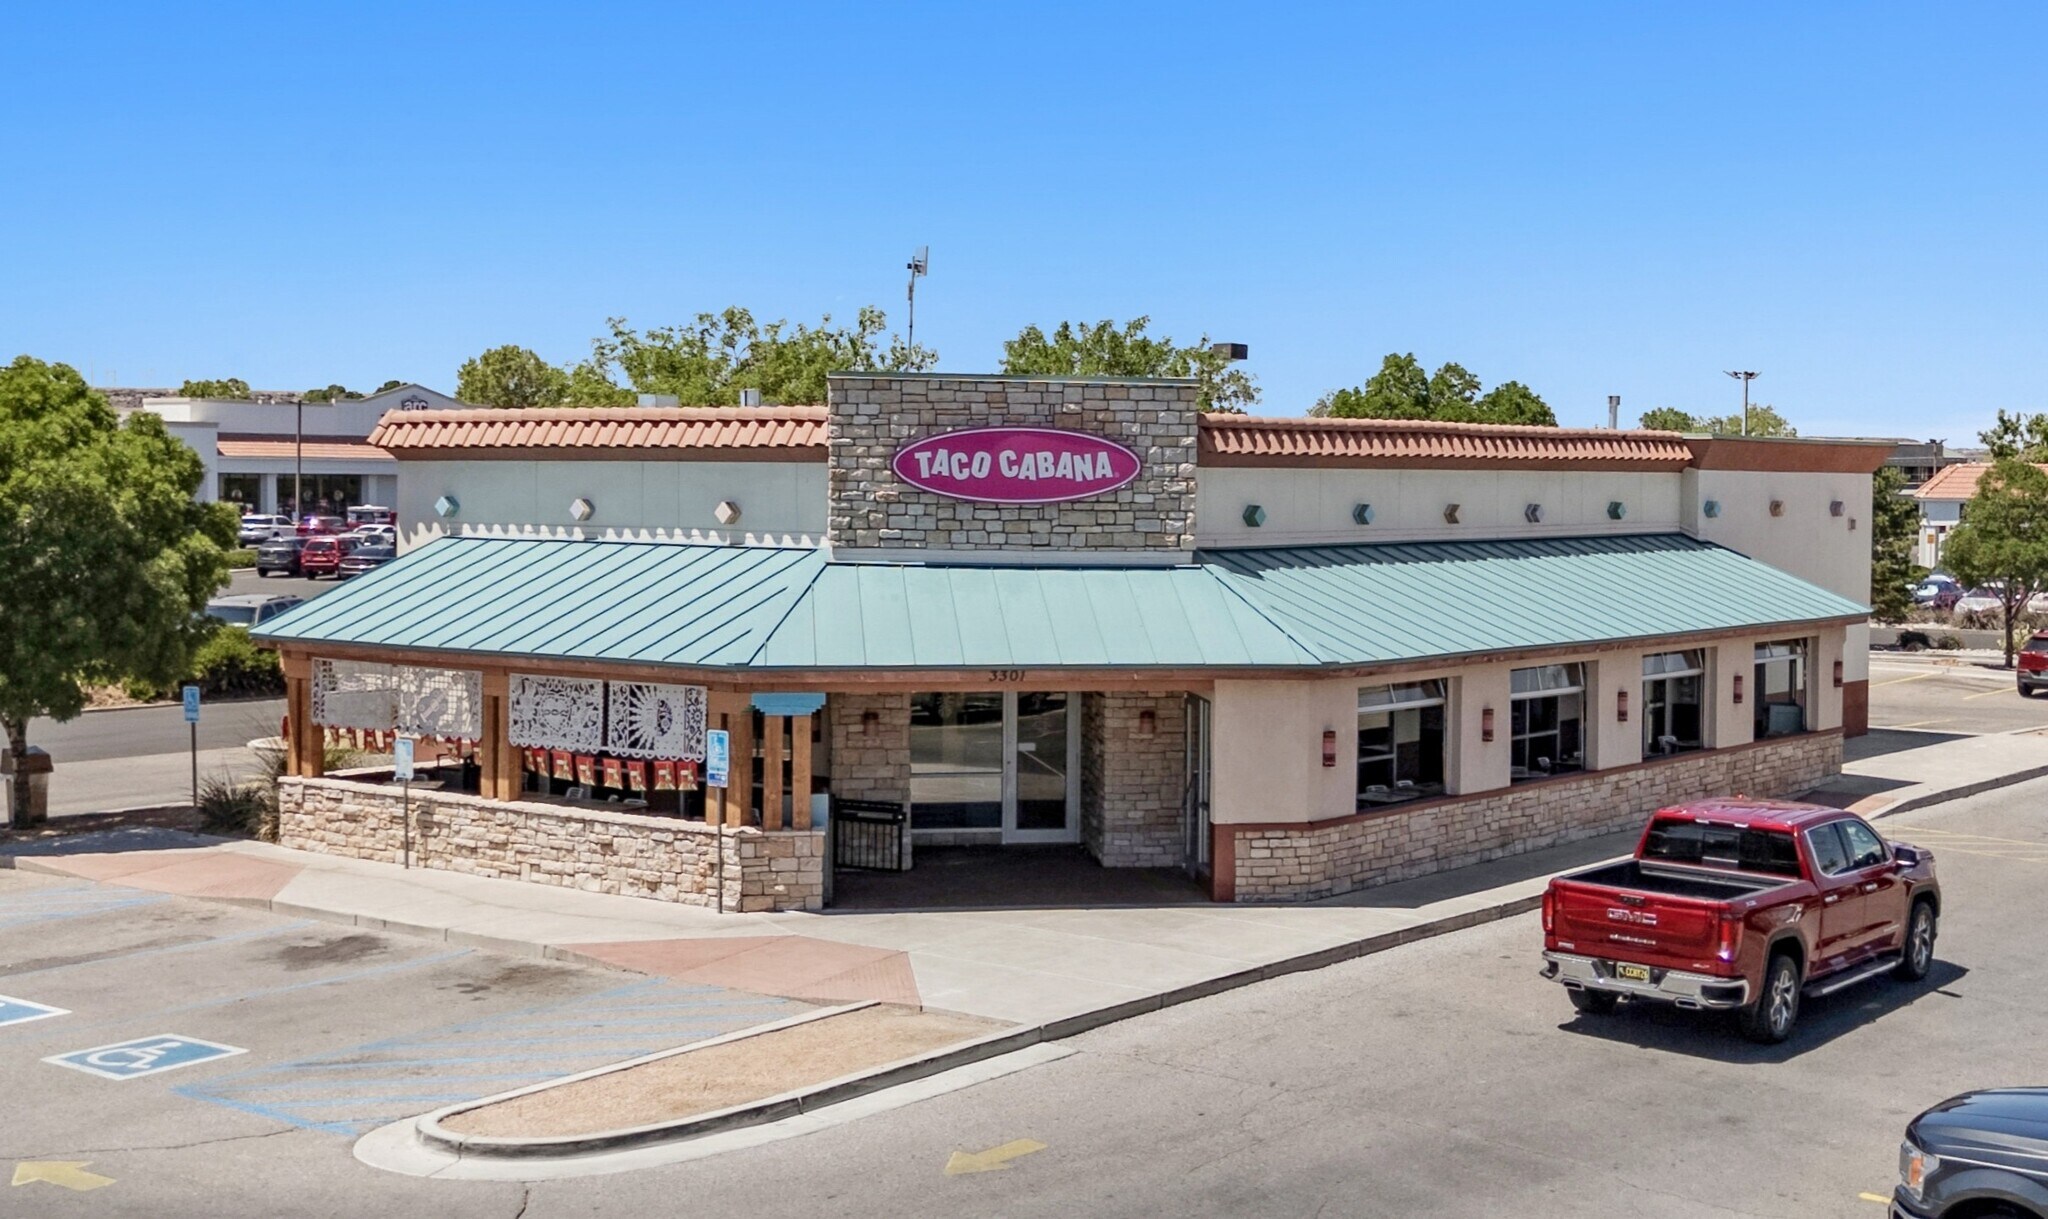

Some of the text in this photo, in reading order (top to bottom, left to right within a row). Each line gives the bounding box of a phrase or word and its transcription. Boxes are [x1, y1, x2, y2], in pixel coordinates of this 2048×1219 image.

[914, 448, 1113, 482] TACO CABANA
[989, 670, 1026, 682] 3301
